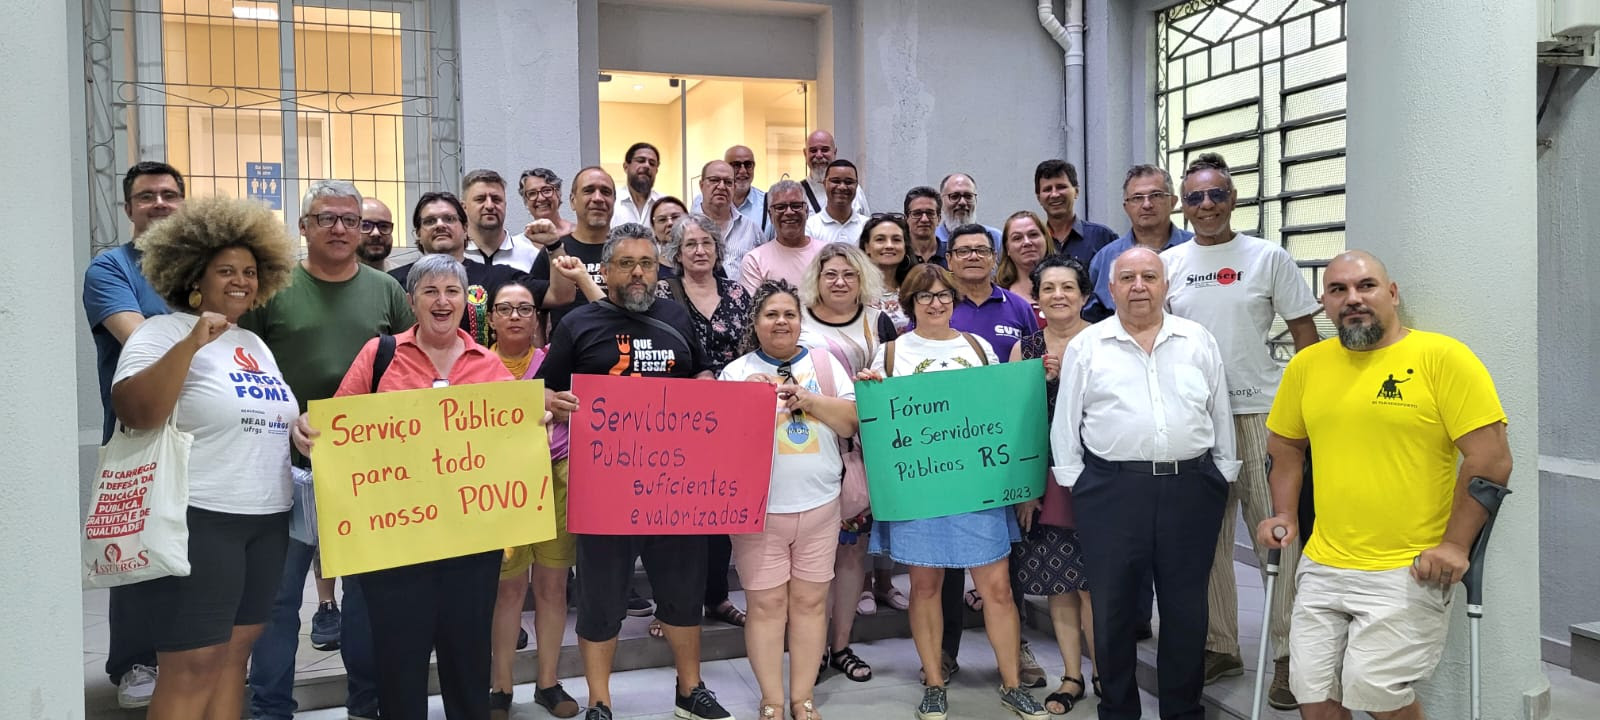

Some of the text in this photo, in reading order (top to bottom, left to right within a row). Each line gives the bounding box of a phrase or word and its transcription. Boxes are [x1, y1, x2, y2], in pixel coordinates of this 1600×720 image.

[1186, 271, 1244, 285] Sindiserf
[994, 324, 1021, 337] CUT
[633, 339, 653, 350] QUE
[634, 349, 675, 361] JUSTIÇA
[633, 359, 640, 371] É
[229, 373, 282, 386] UFRGS
[235, 385, 290, 402] FOME
[590, 385, 719, 434] Servidores
[889, 396, 950, 420] Fórum
[241, 417, 266, 426] NEAB
[268, 421, 289, 430] UFRGS
[331, 398, 525, 446] Serviço Público
[892, 417, 1003, 449] de Servidores
[591, 439, 686, 468] Públicos
[102, 462, 157, 479] EU CARREGO
[351, 441, 486, 496] para todo
[894, 444, 1010, 481] Públicos RS
[98, 474, 154, 490] A DEFESA DA
[633, 470, 738, 497] suficientes
[1002, 486, 1032, 502] 2023
[140, 507, 151, 517] DE
[337, 520, 352, 536] o
[369, 504, 438, 531] nosso
[630, 508, 640, 525] e
